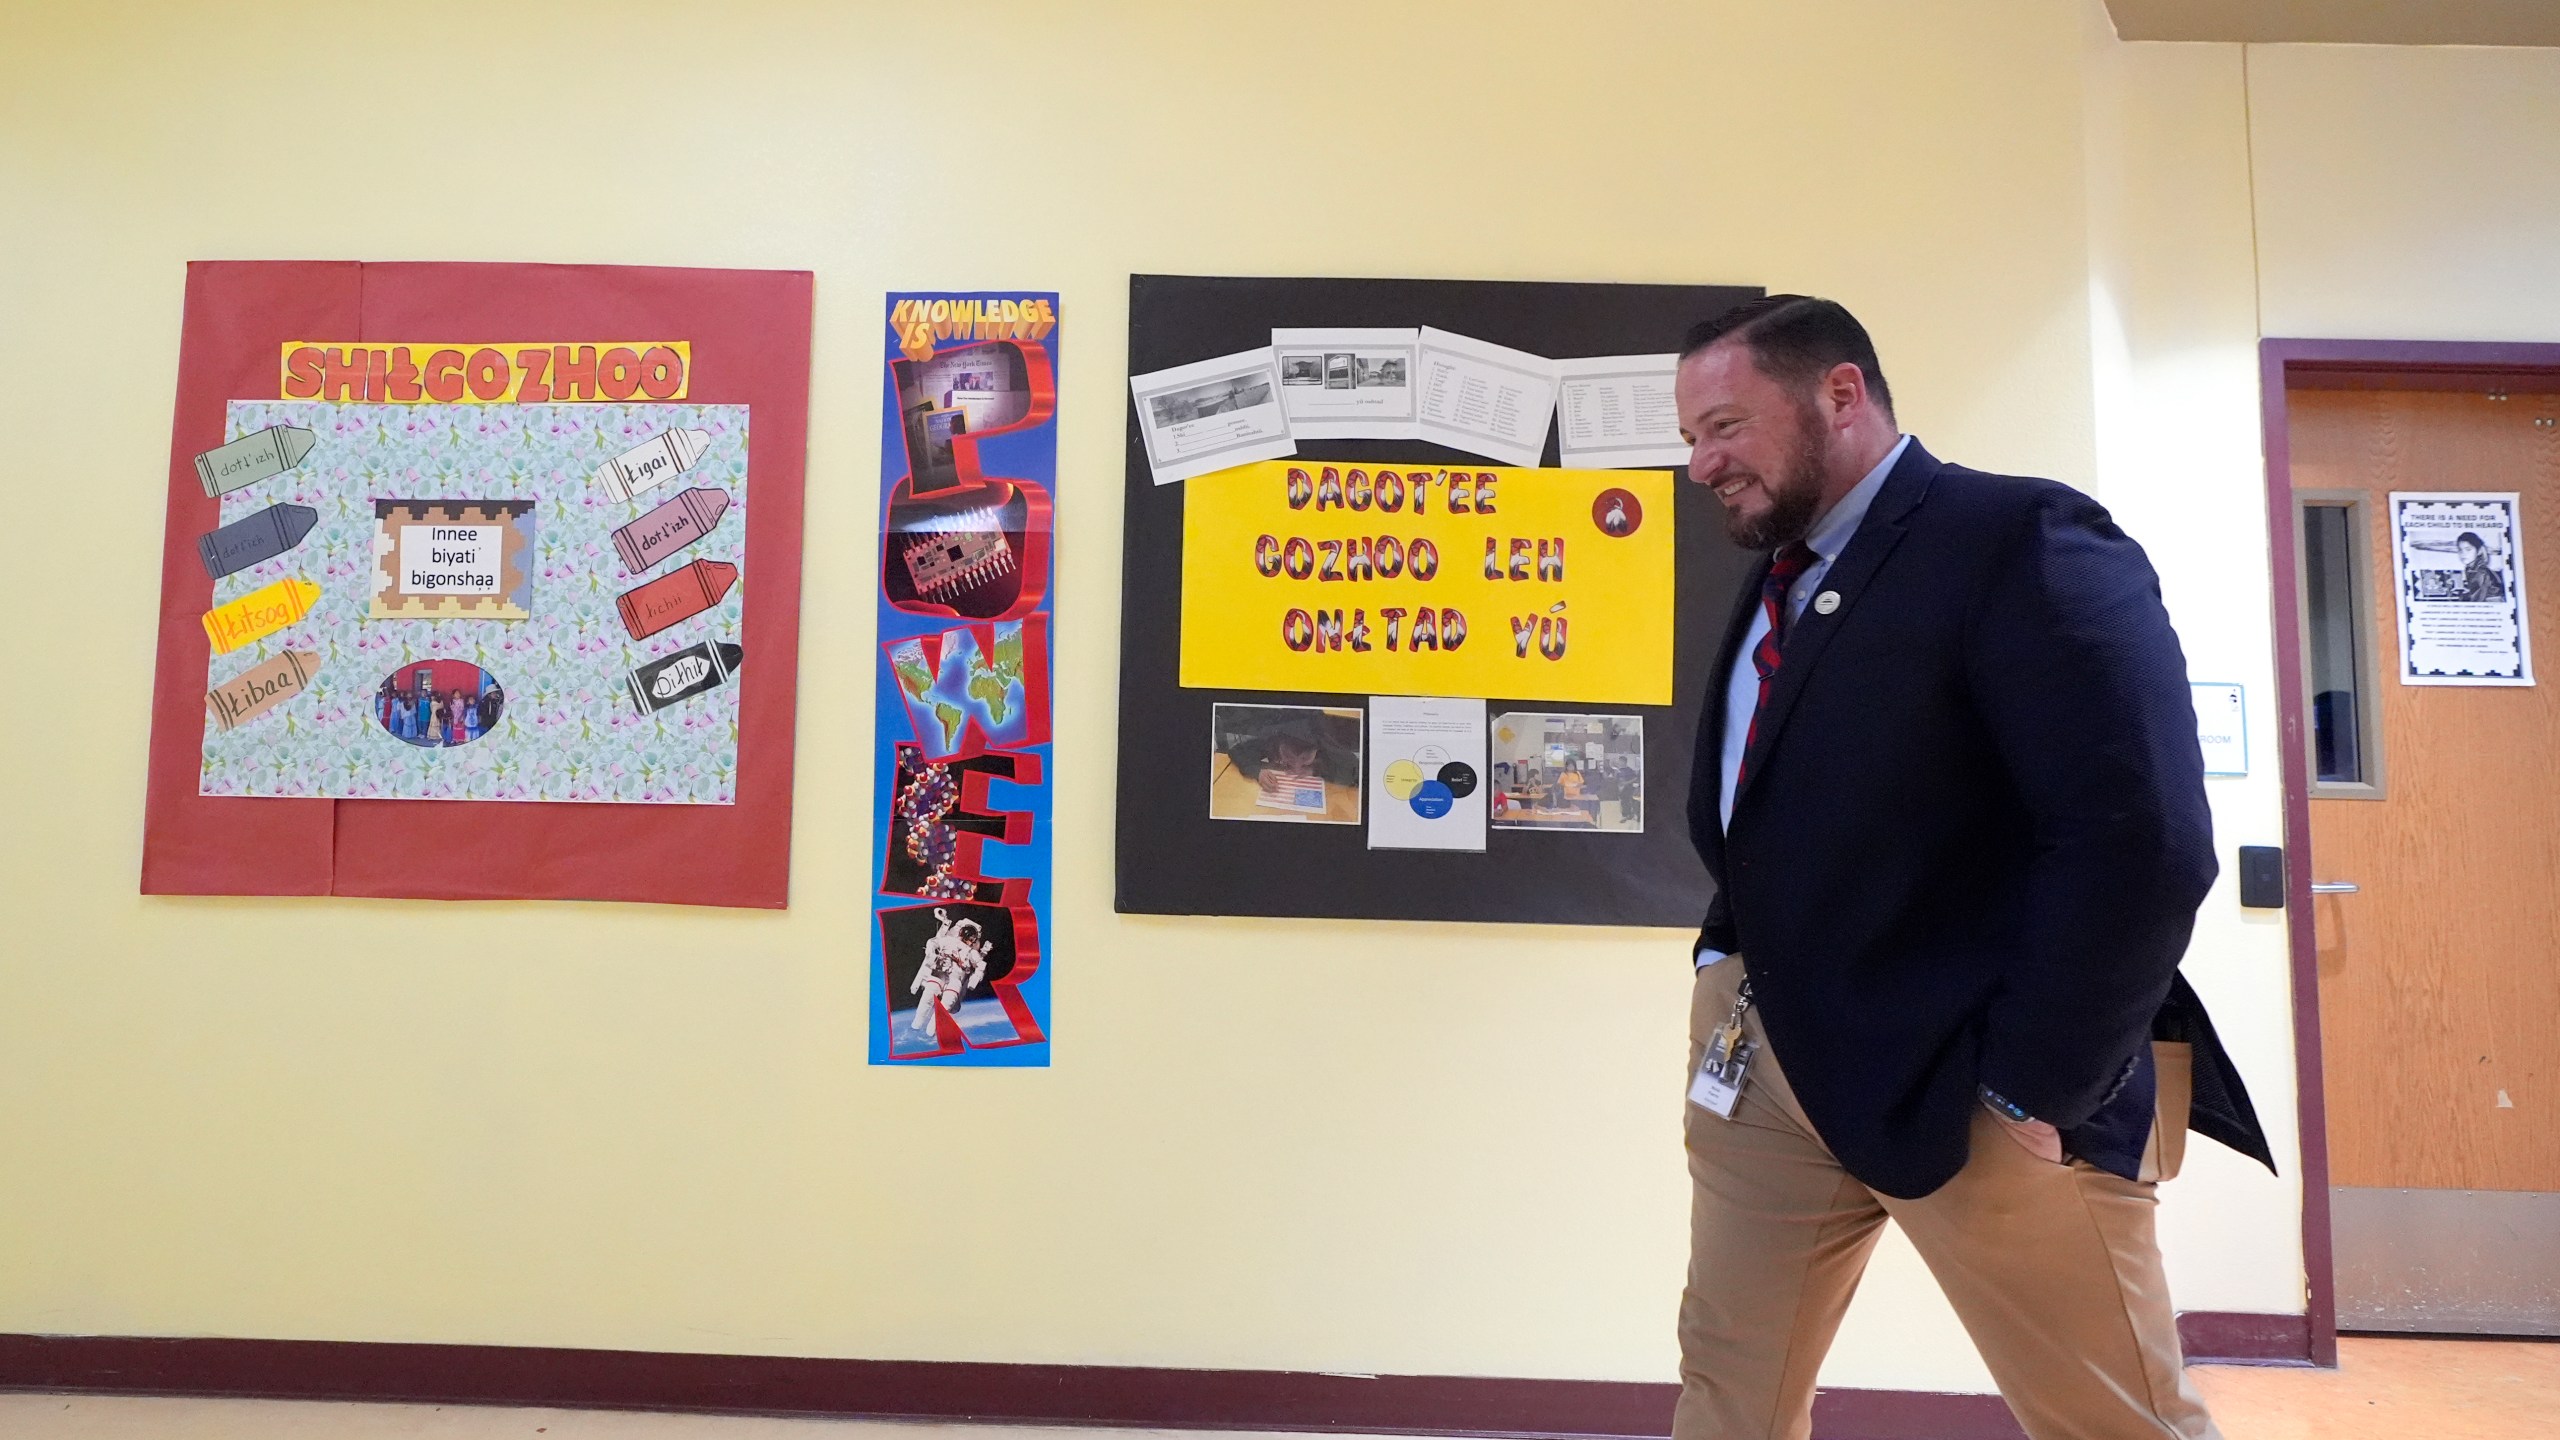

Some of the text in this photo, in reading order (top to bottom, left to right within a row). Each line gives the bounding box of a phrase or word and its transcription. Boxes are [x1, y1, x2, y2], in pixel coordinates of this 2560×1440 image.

[890, 299, 1056, 333] KNOWLEDGE
[899, 321, 932, 355] IS
[432, 527, 477, 541] Innee
[1254, 534, 1564, 582] GOZHOO LEH
[1510, 600, 1568, 661] YÚ
